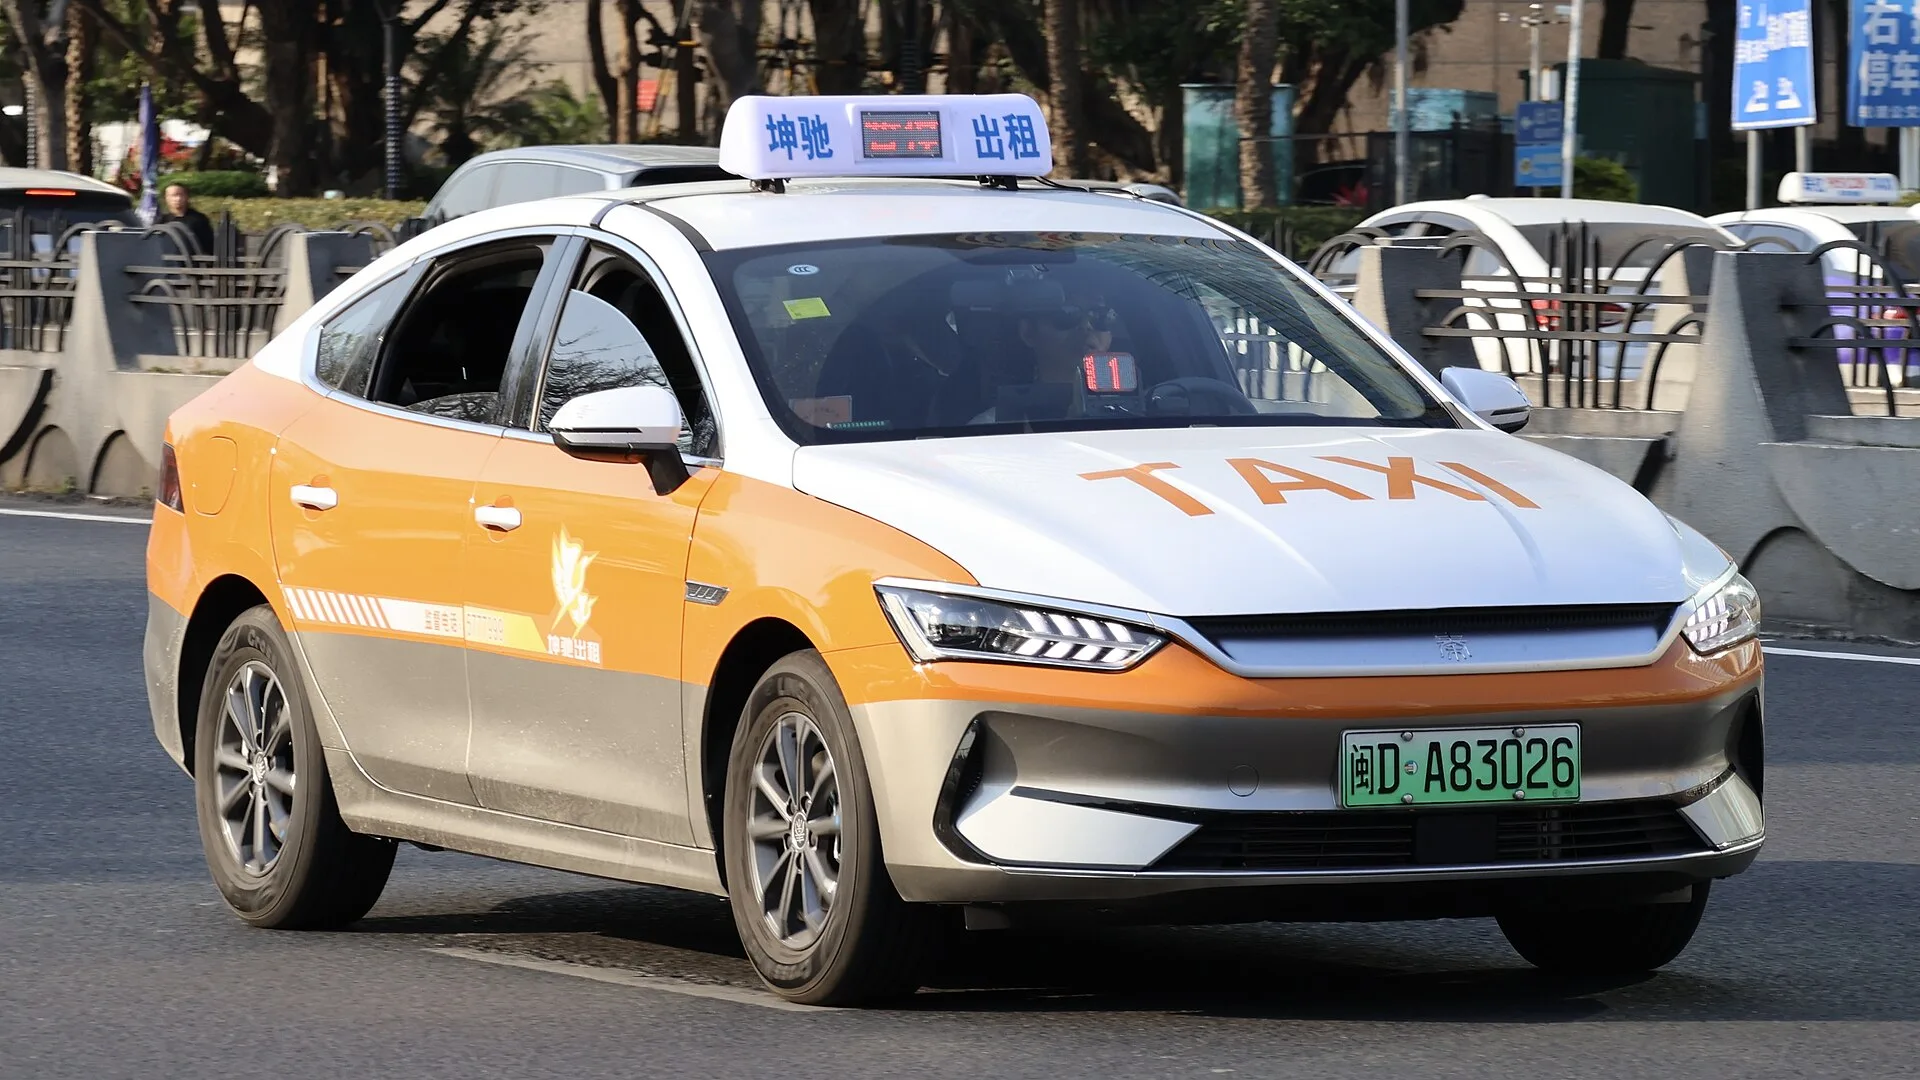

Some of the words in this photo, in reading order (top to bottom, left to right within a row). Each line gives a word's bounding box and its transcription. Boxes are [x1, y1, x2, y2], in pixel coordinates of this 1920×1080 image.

[1863, 0, 1920, 45] 右
[1859, 50, 1920, 96] 停车
[766, 113, 834, 161] 坤驰
[972, 113, 1041, 161] 出租
[1108, 357, 1121, 390] 1
[1076, 455, 1542, 517] TAXI
[1351, 743, 1400, 796] 闽D
[1424, 736, 1576, 793] A83026
